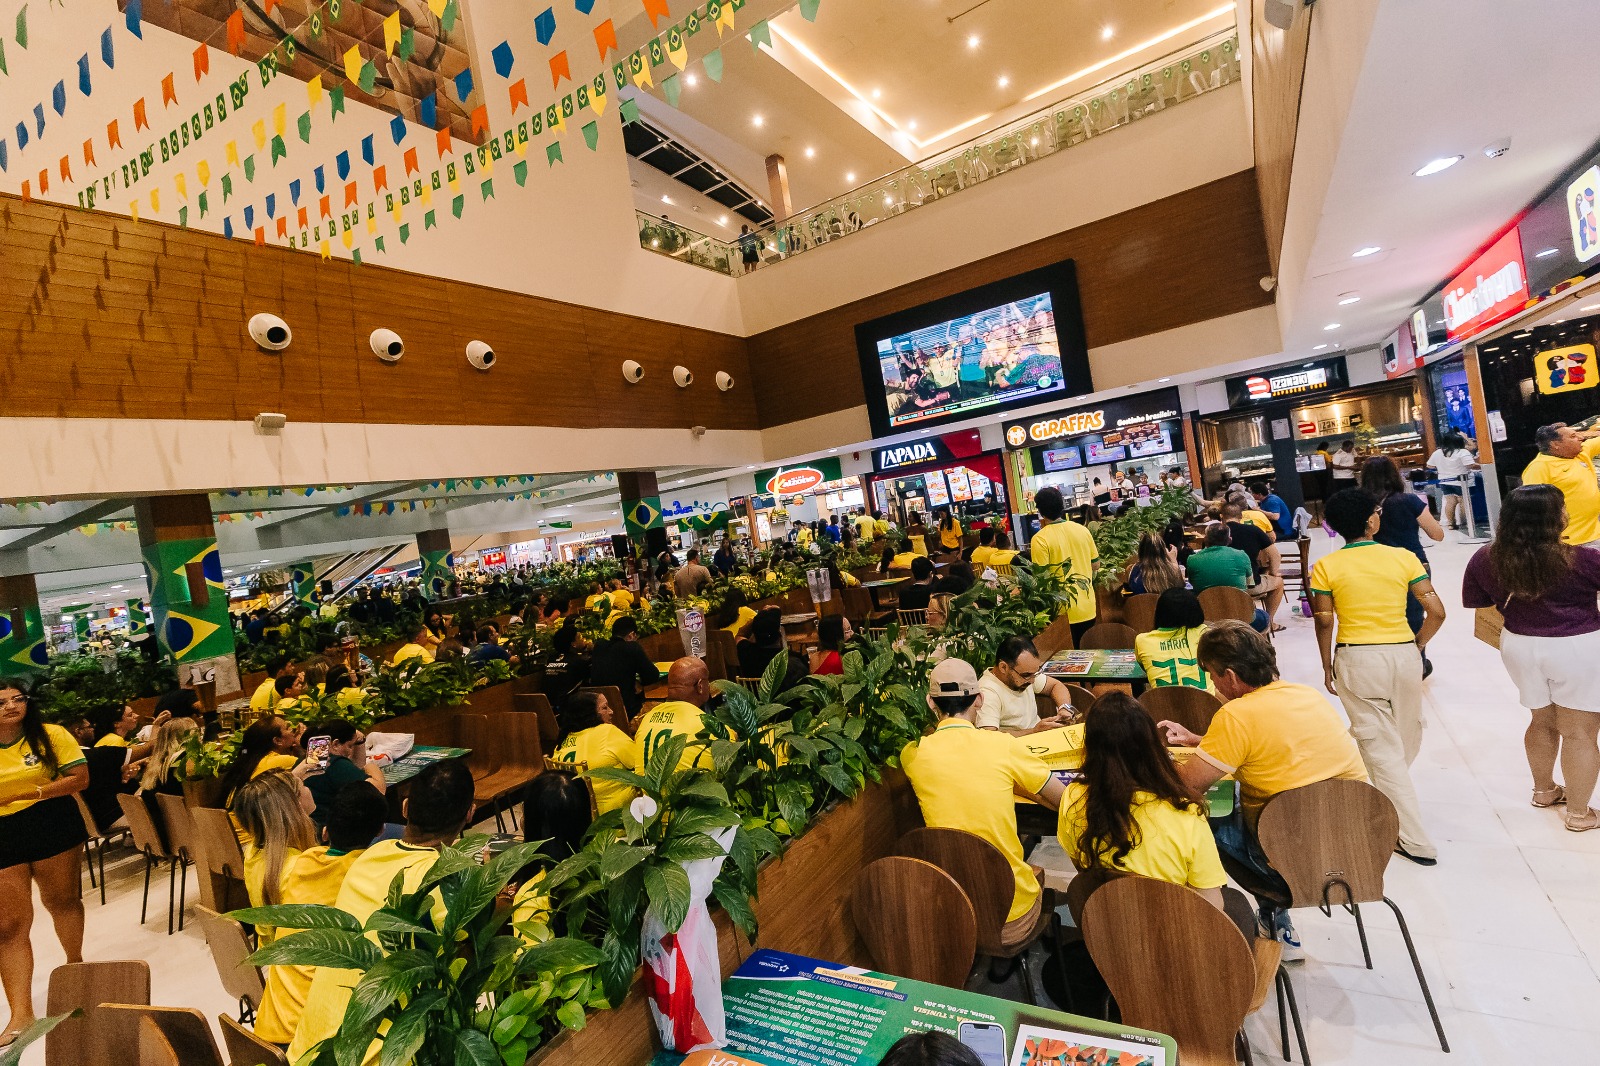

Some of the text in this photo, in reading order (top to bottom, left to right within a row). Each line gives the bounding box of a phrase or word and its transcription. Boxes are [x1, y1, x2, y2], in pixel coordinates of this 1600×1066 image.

[1443, 261, 1523, 332] Chinatown
[881, 442, 937, 469] LAPADA
[1160, 638, 1189, 651] MARIA
[649, 712, 675, 724] BRASIL
[884, 991, 904, 1000] TORCIDA
[840, 1000, 859, 1009] beleza
[946, 1004, 968, 1014] 25/06,
[863, 1006, 886, 1015] ousadia
[913, 1006, 947, 1018] TUNÍSIA
[970, 1010, 995, 1020] Quinta,
[834, 1015, 851, 1024] finais
[858, 1013, 882, 1023] seleção
[770, 1024, 790, 1033] mundo
[863, 1023, 877, 1031] Com
[849, 1028, 872, 1038] esporte
[1120, 1031, 1145, 1042] fifa.com
[816, 1046, 836, 1056] global
[834, 1042, 850, 1050] anos
[850, 1046, 863, 1054] Nos
[760, 1049, 786, 1061] seleções
[835, 1051, 857, 1062] torneio
